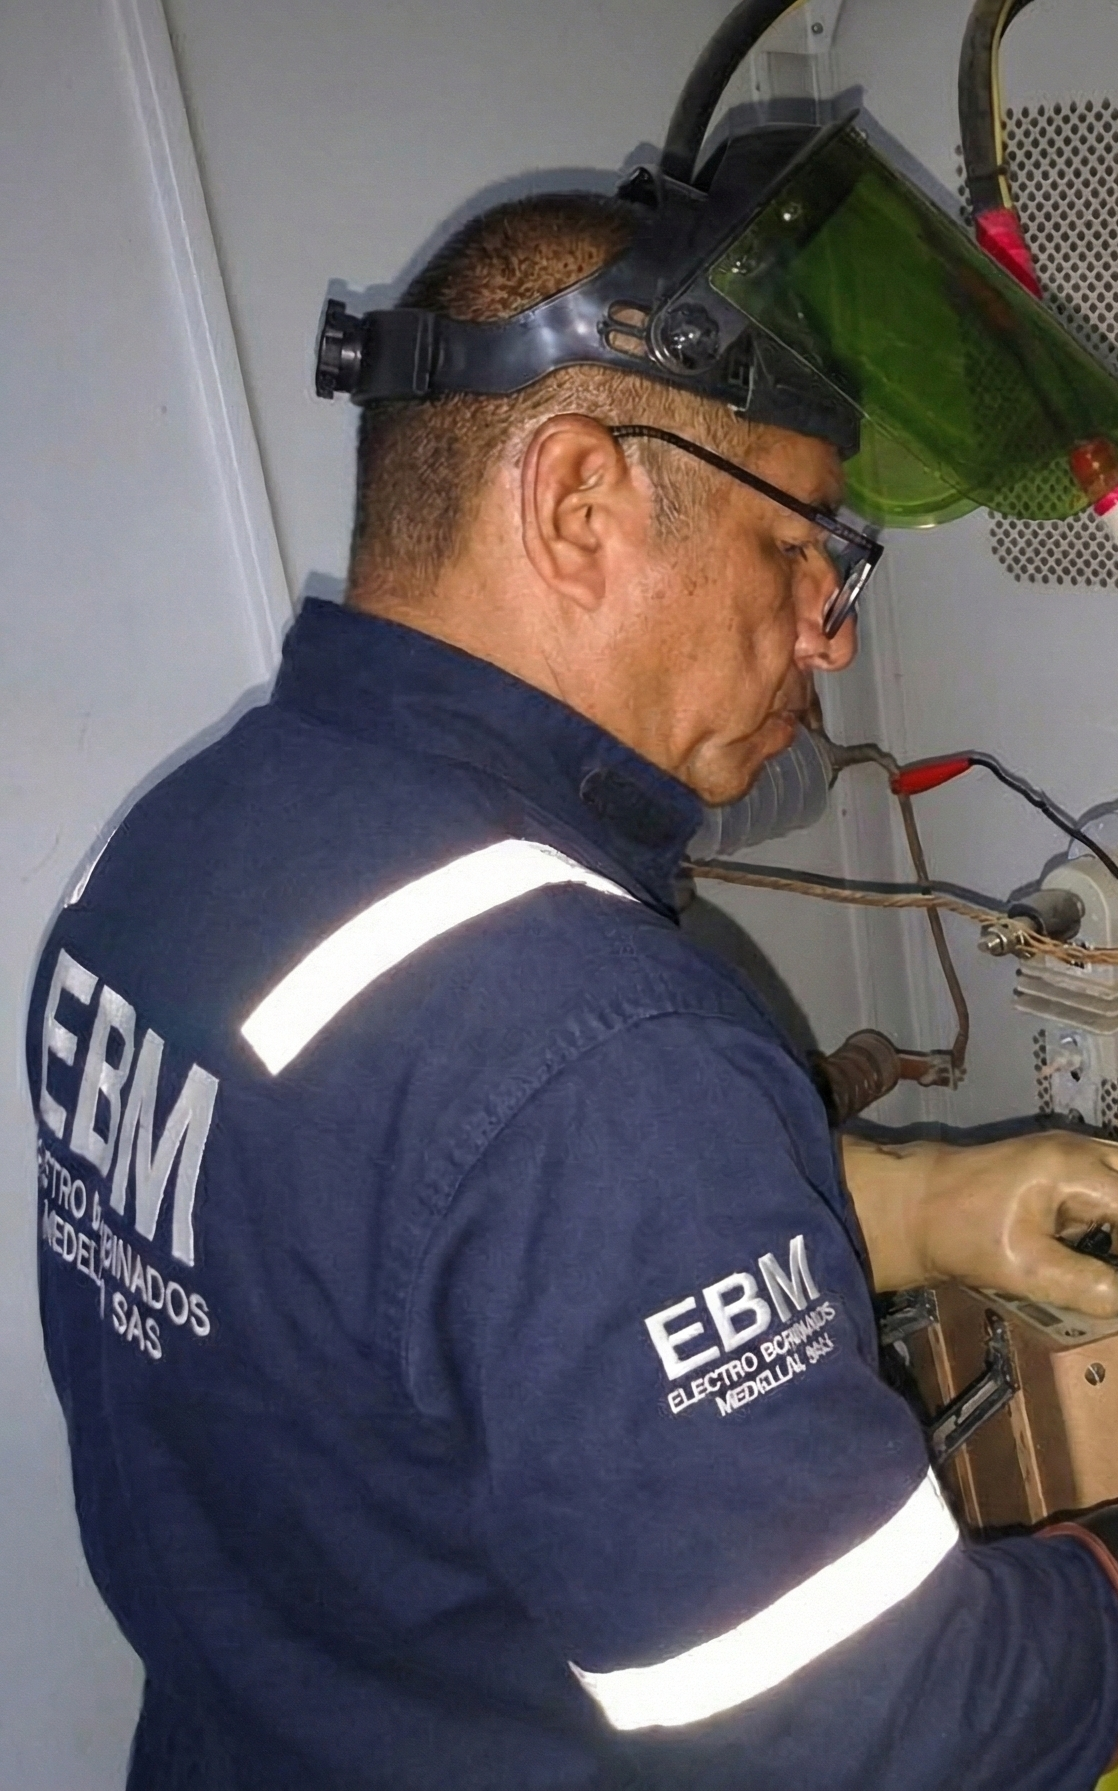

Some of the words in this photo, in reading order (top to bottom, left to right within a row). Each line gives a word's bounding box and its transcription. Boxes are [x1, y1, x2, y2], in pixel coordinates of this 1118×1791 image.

[40, 948, 219, 1267] EBM
[112, 1292, 162, 1360] SAS
[644, 1234, 821, 1381] EBM
[667, 1352, 758, 1414] ELECTRO
